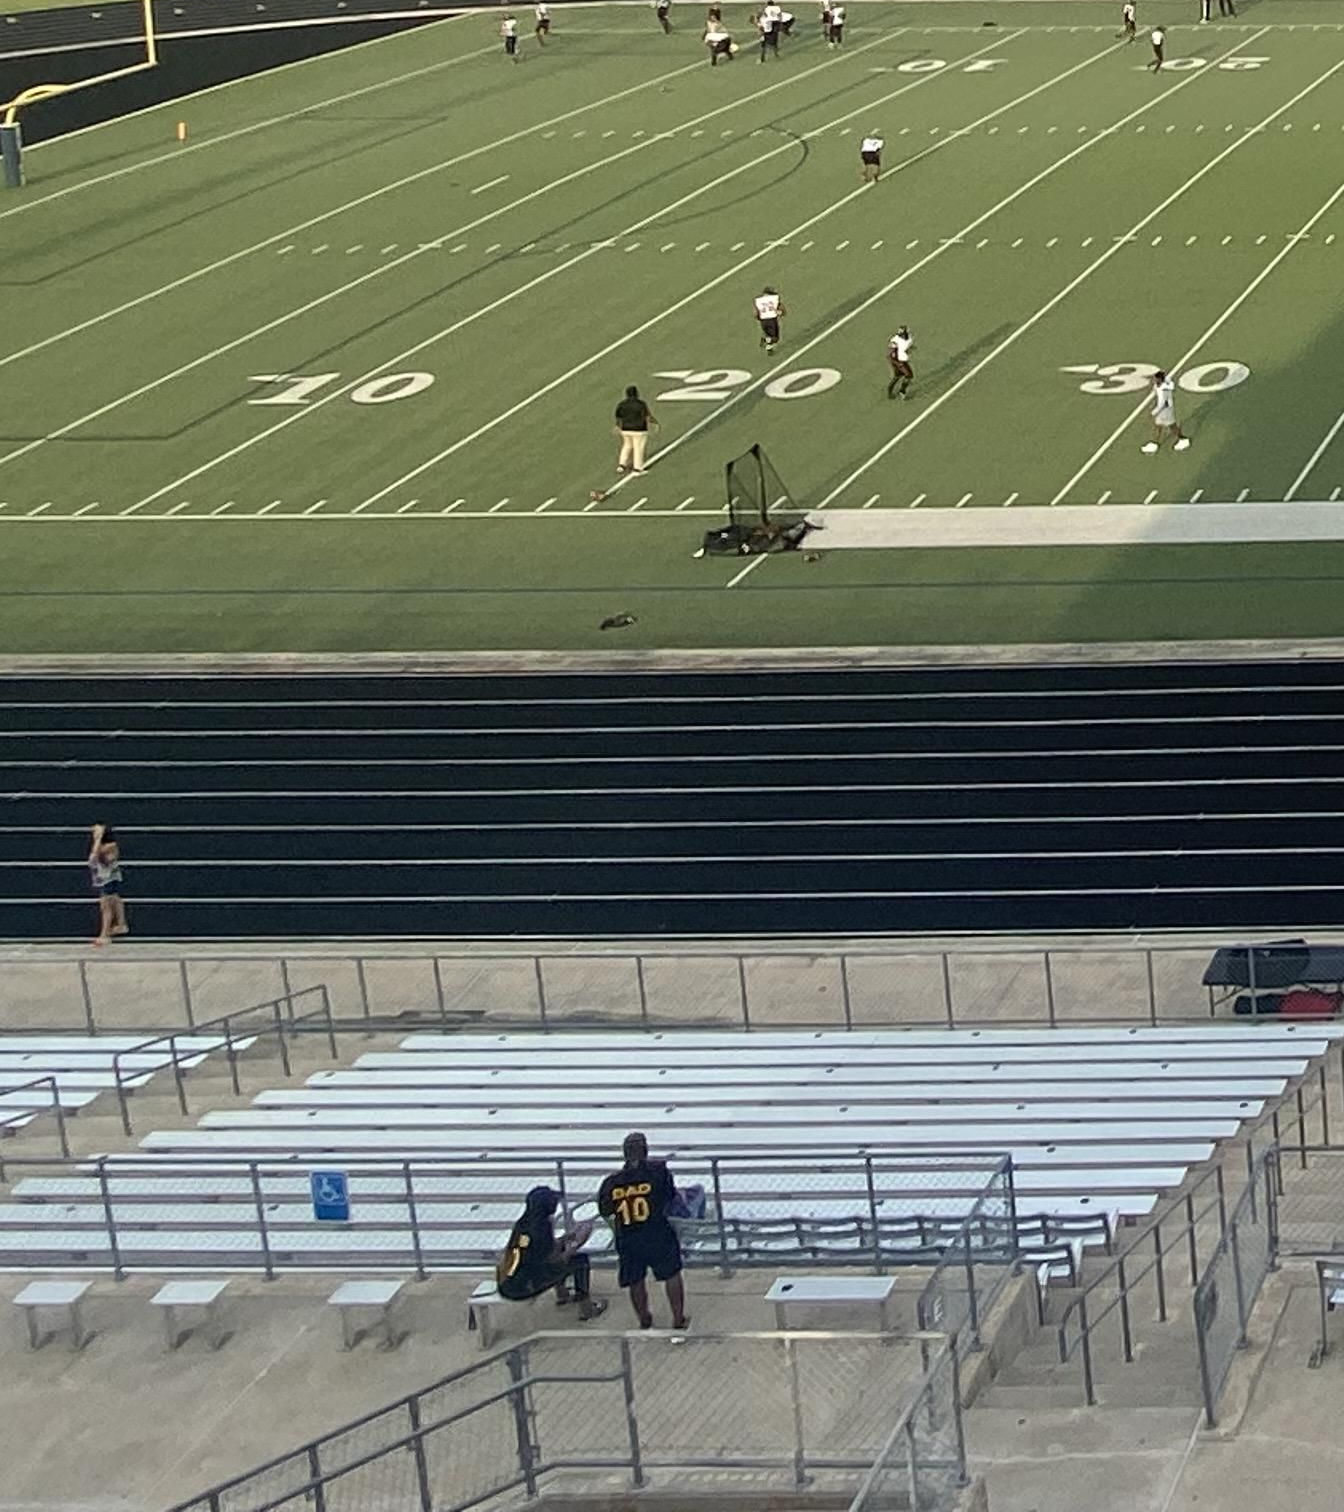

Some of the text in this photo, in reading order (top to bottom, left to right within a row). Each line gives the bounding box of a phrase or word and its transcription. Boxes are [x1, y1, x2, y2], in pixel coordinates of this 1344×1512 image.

[247, 372, 436, 405] 10
[654, 368, 842, 400] 20
[1079, 361, 1251, 394] 30
[612, 1183, 652, 1201] DAD
[617, 1197, 650, 1225] 10
